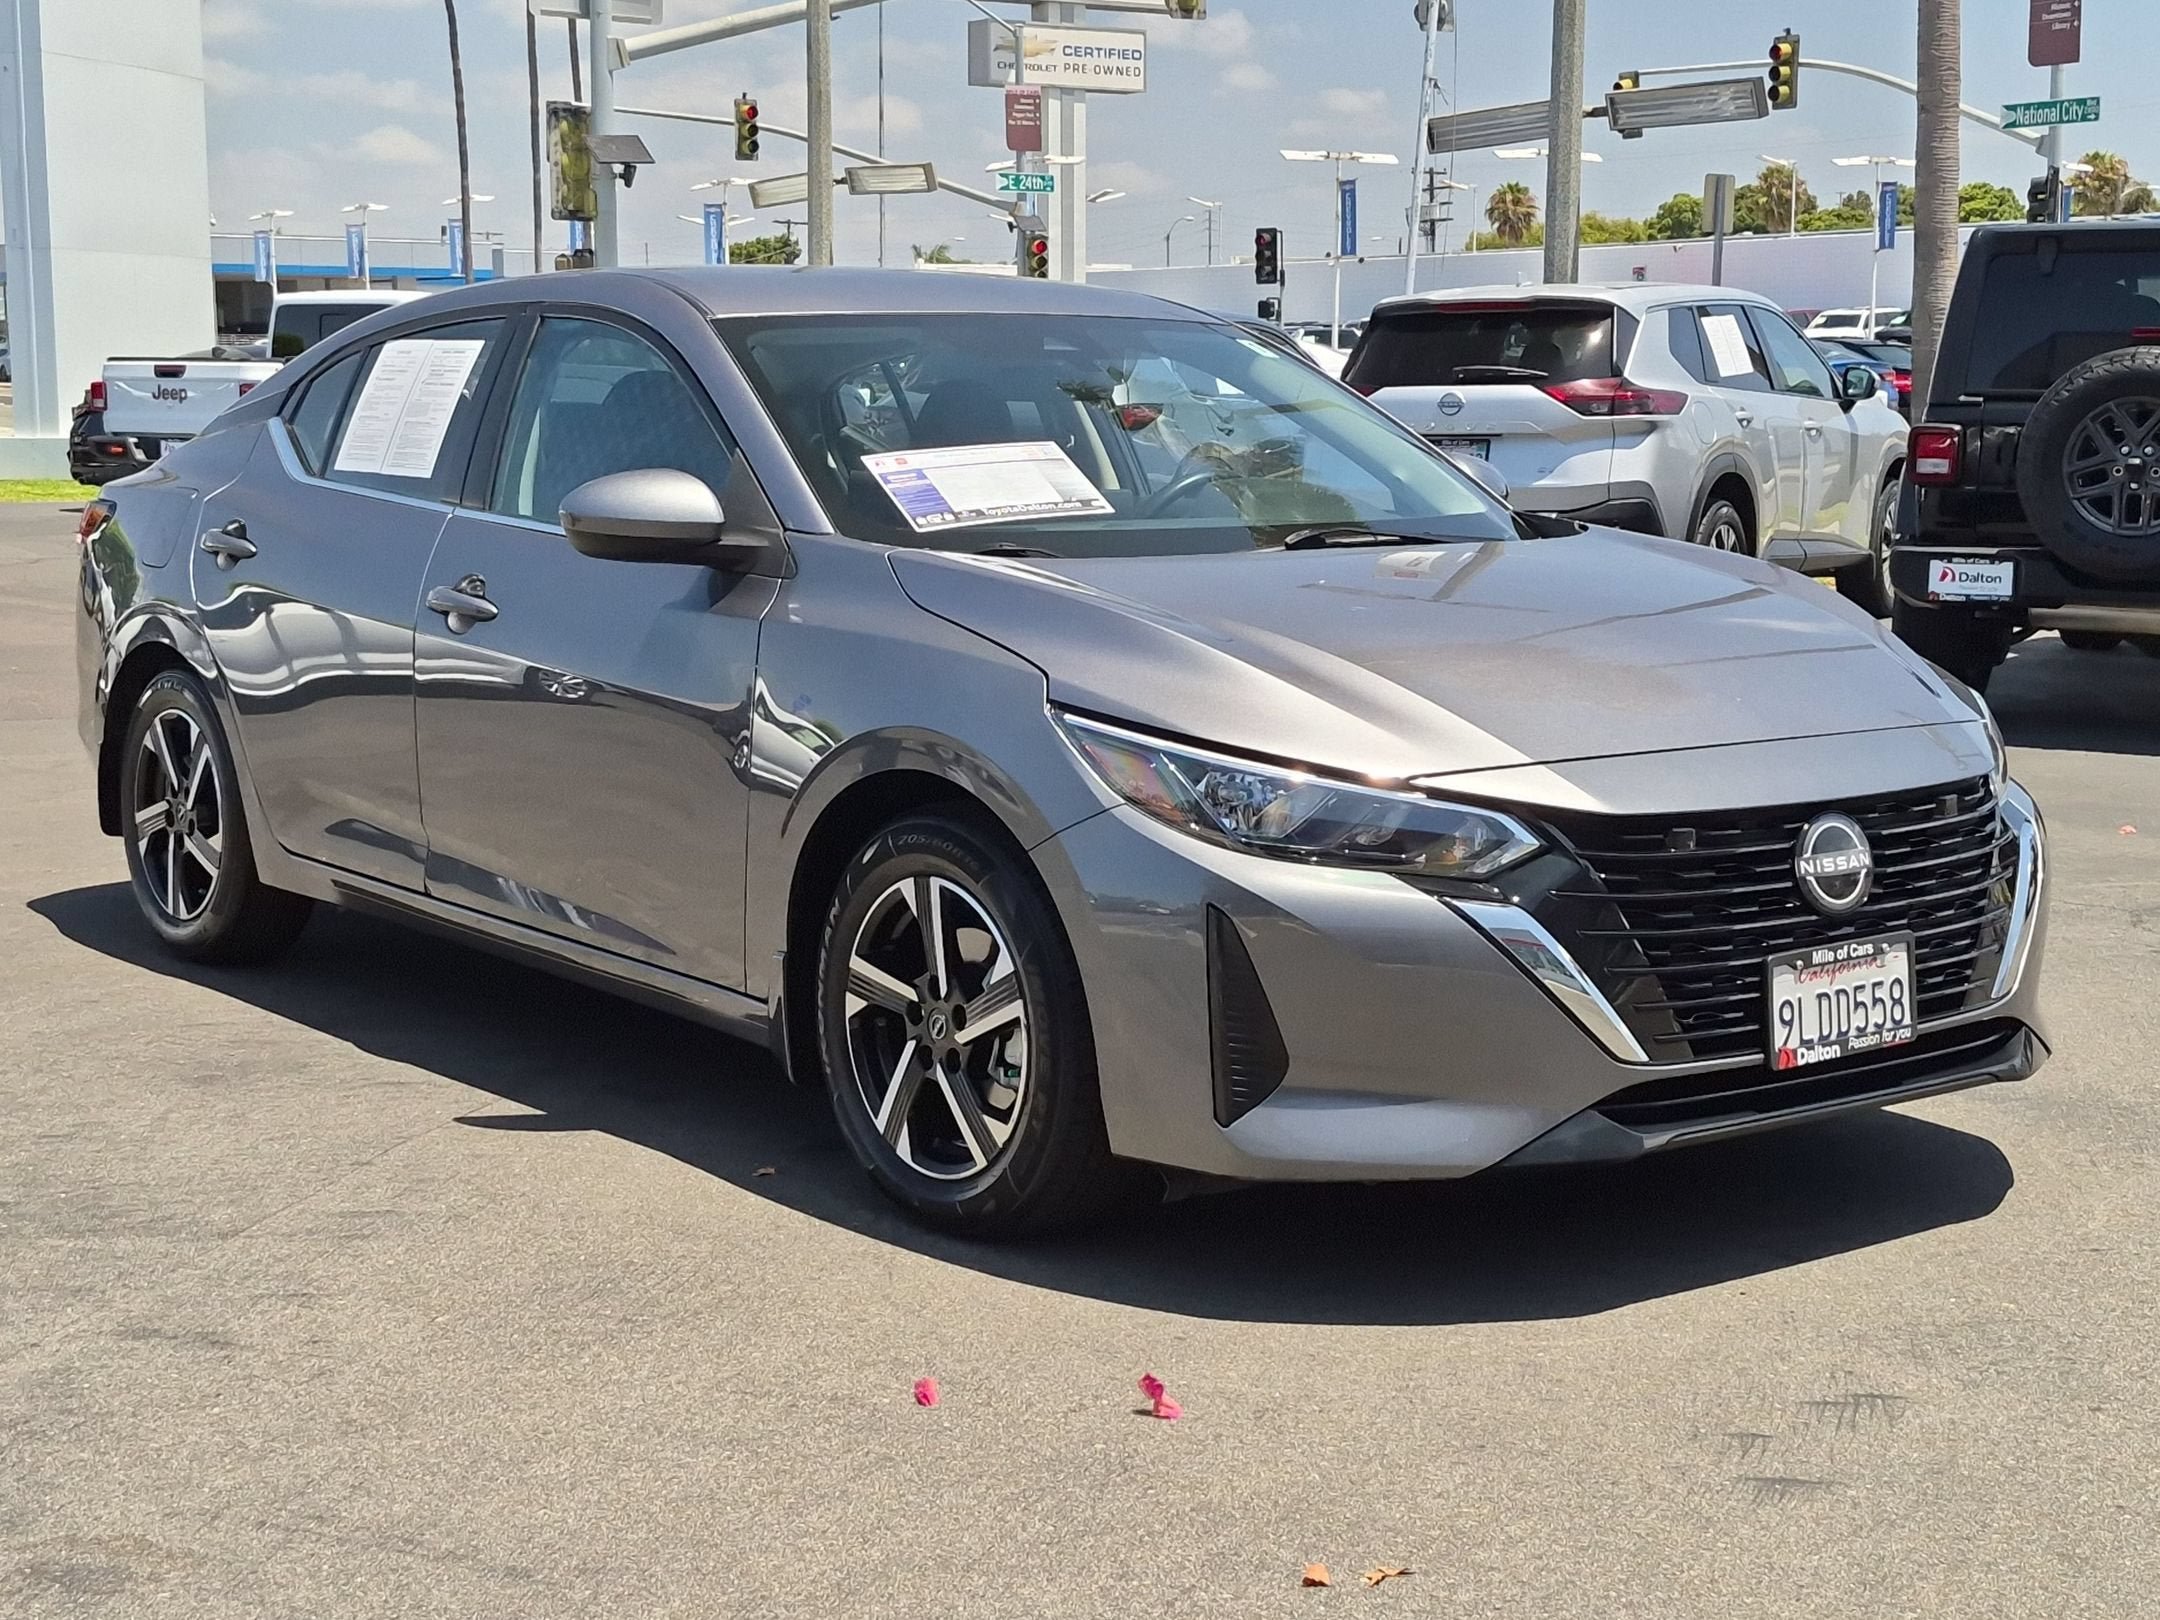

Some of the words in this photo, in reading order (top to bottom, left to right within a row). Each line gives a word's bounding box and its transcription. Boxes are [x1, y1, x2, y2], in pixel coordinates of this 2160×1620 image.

[1062, 44, 1143, 61] CERTIFIED
[997, 60, 1059, 73] CHEROLET
[1063, 62, 1142, 78] PRE-OWNED
[2015, 103, 2060, 126] National
[2062, 100, 2085, 122] City
[1008, 175, 1016, 190] E
[1018, 175, 1044, 190] 24th
[152, 384, 188, 405] Jeep
[1958, 571, 2002, 584] Dalton
[1800, 851, 1870, 876] NISSAN
[1812, 947, 1835, 966] Mile
[1836, 945, 1848, 962] of
[1849, 942, 1874, 959] Cars
[1798, 956, 1887, 986] California
[1778, 976, 1906, 1050] 9LDD558
[1796, 1042, 1841, 1066] Dalton
[1847, 1032, 1881, 1051] Passion
[1881, 1028, 1894, 1043] for
[1894, 1026, 1912, 1042] you
